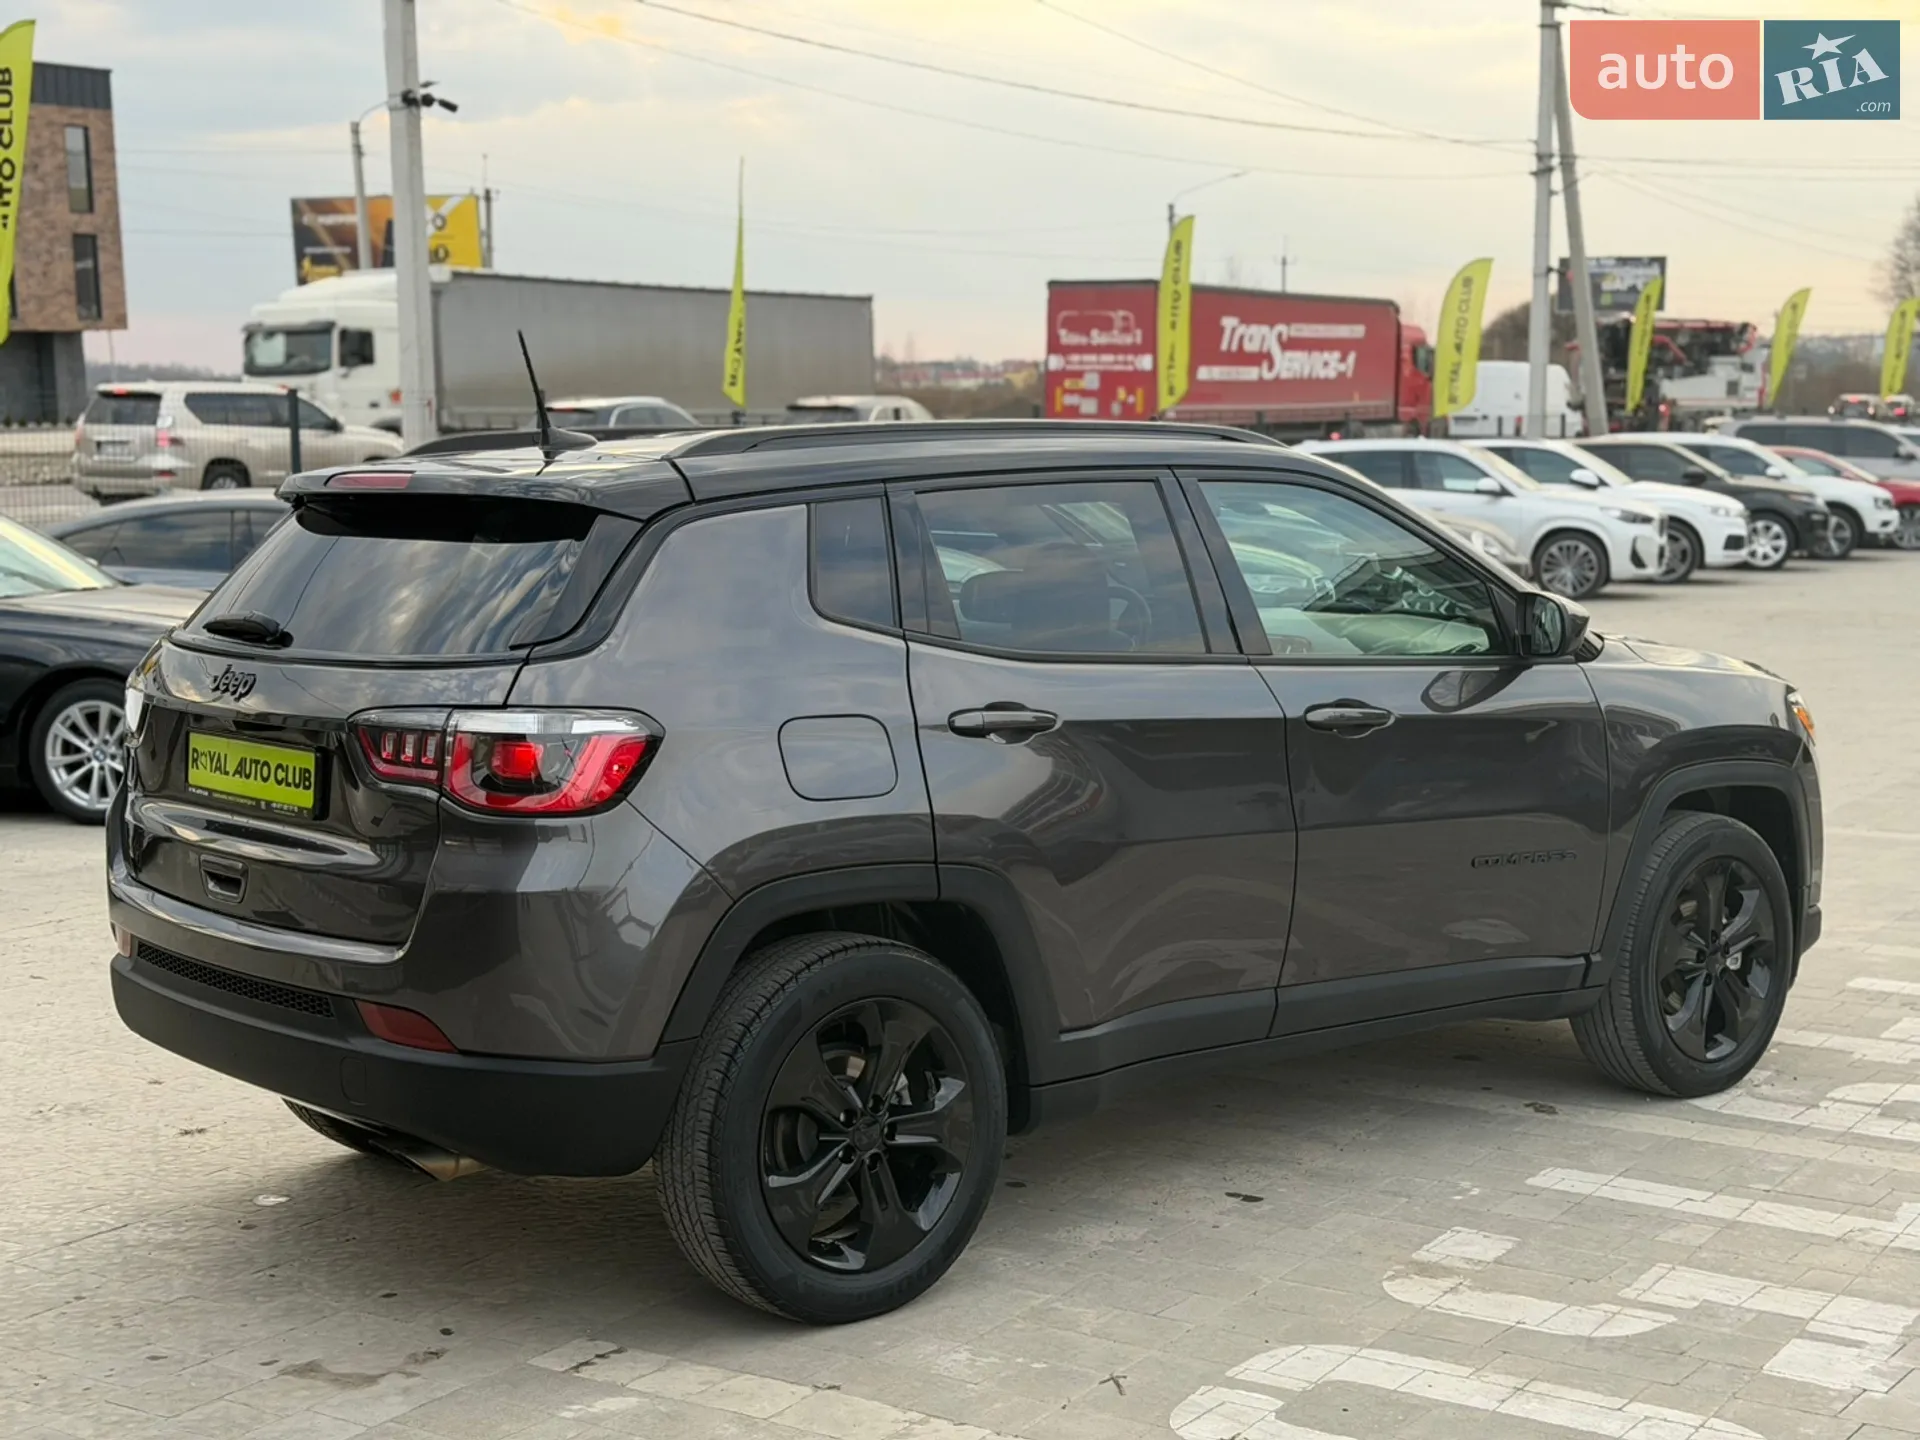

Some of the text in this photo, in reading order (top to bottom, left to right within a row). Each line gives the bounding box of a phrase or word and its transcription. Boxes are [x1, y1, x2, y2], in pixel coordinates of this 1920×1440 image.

[0, 67, 16, 230] TO CLUB
[1457, 276, 1474, 314] CLUB
[211, 664, 257, 701] Jeep
[231, 757, 271, 783] AUTO
[274, 763, 312, 791] CLUB
